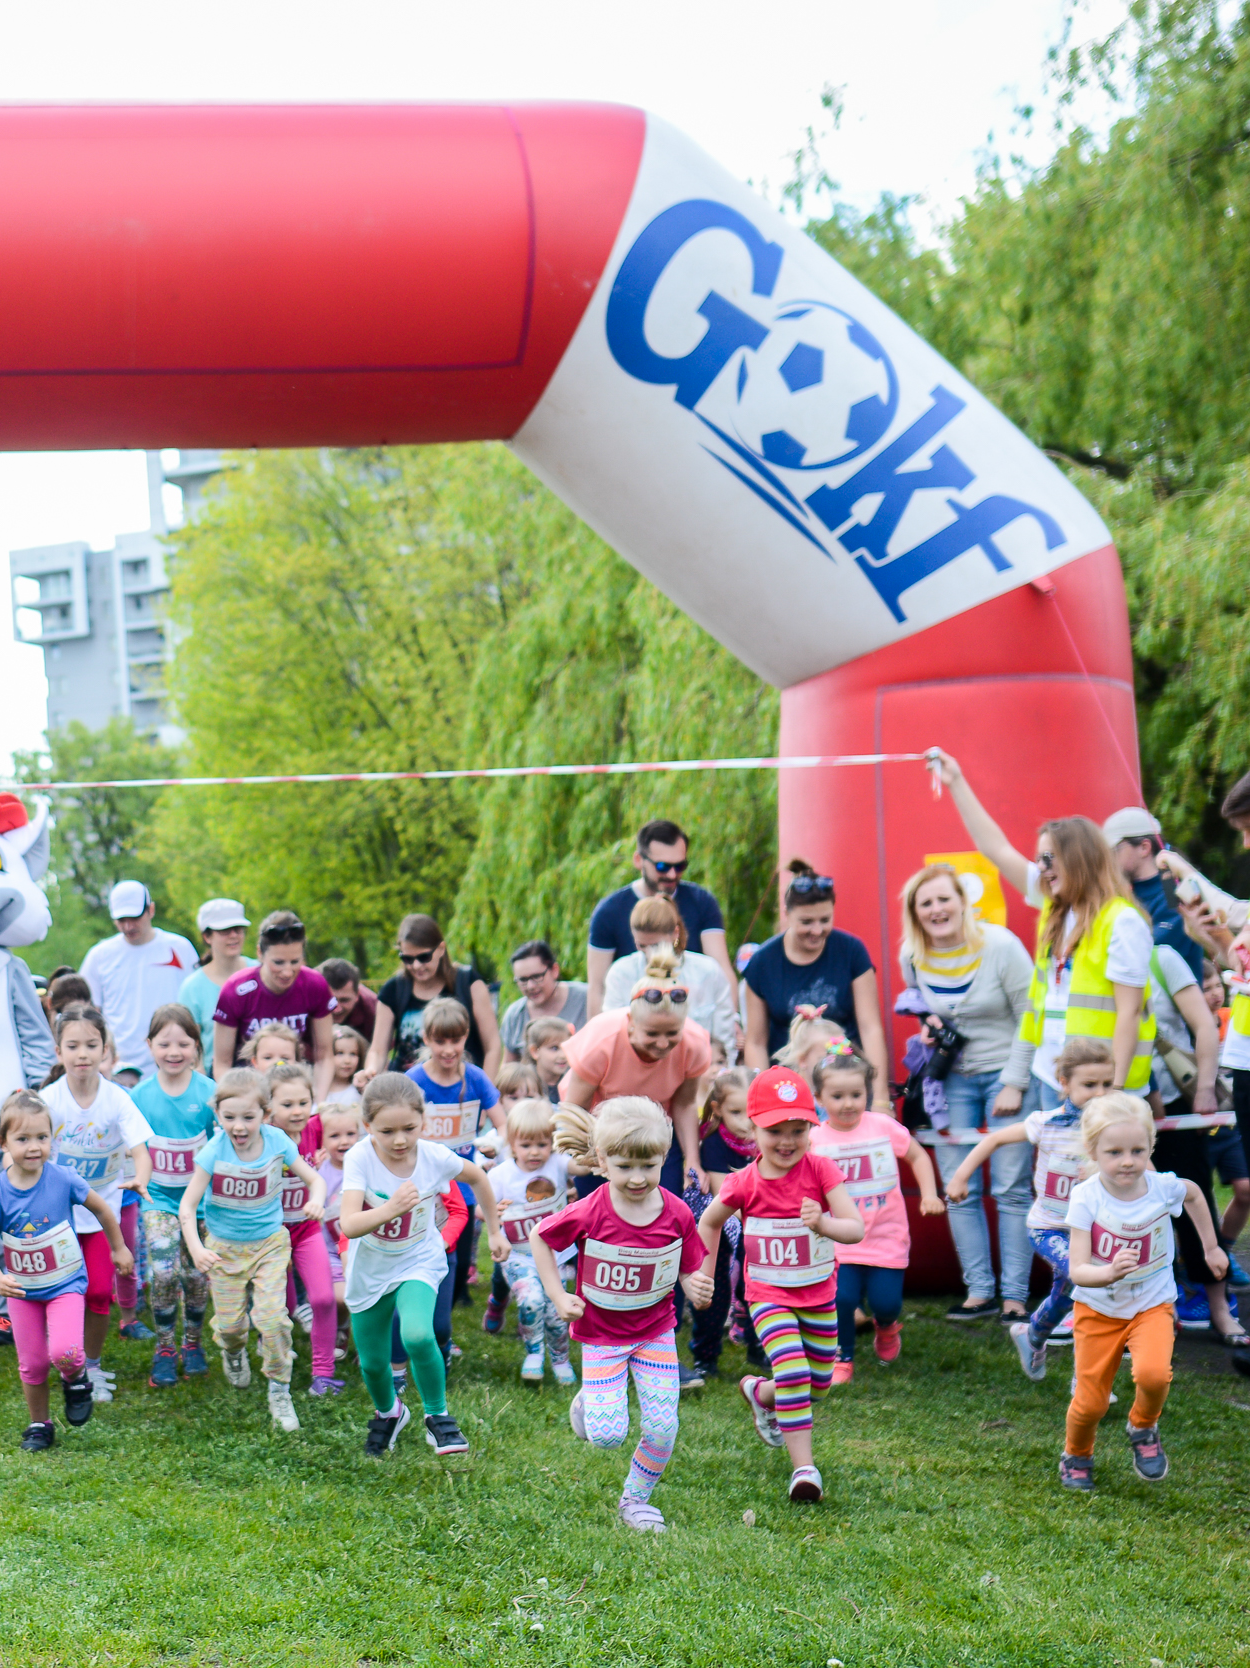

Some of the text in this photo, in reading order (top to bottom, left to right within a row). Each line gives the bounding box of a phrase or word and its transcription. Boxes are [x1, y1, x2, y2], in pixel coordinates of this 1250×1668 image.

[154, 1150, 187, 1172] 014
[835, 1158, 861, 1180] 77
[222, 1177, 259, 1197] 080
[283, 1189, 304, 1208] 10
[377, 1216, 402, 1238] 13
[514, 1216, 542, 1240] 10
[10, 1251, 47, 1273] 048
[757, 1238, 799, 1265] 104
[595, 1262, 641, 1291] 095
